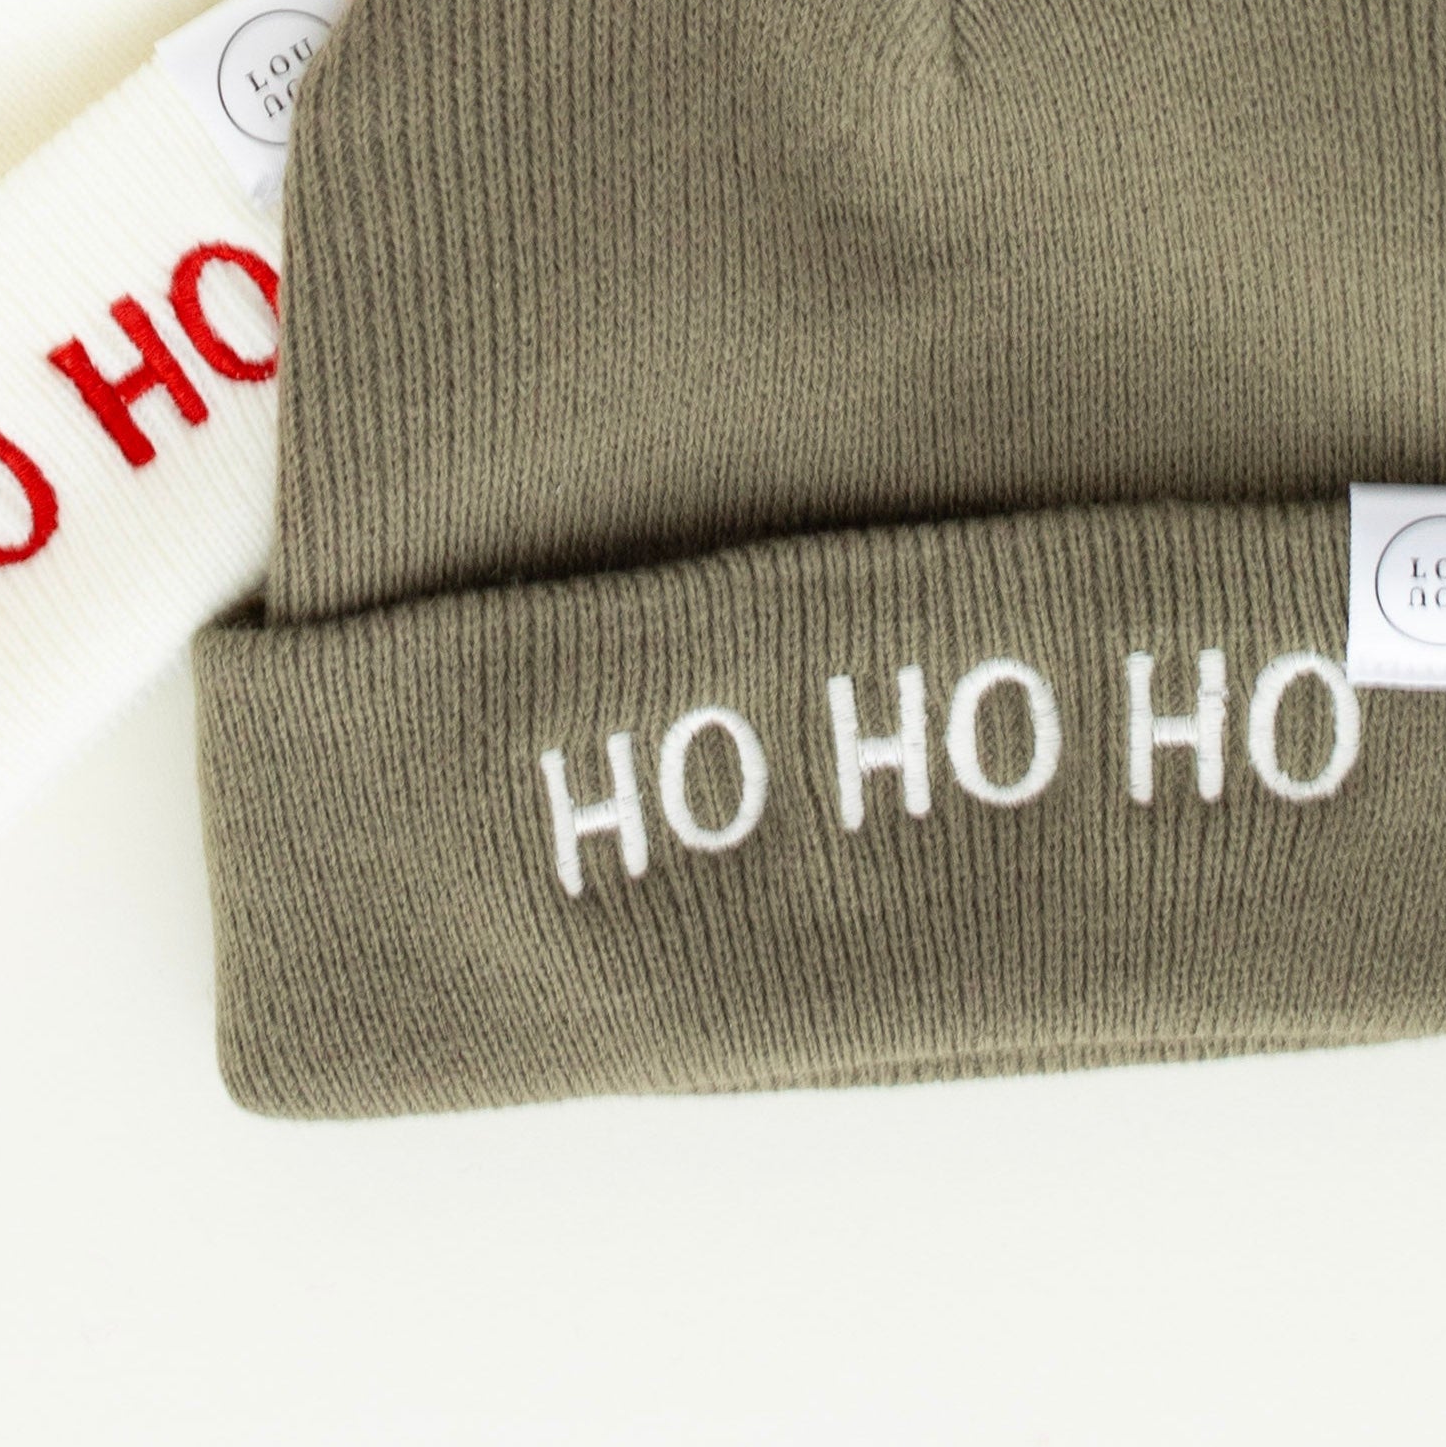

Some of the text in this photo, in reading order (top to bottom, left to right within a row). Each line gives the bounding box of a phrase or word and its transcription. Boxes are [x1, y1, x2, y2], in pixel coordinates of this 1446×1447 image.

[246, 37, 314, 93] LOU
[46, 241, 281, 470] HO
[539, 647, 1361, 898] HO HO HO
